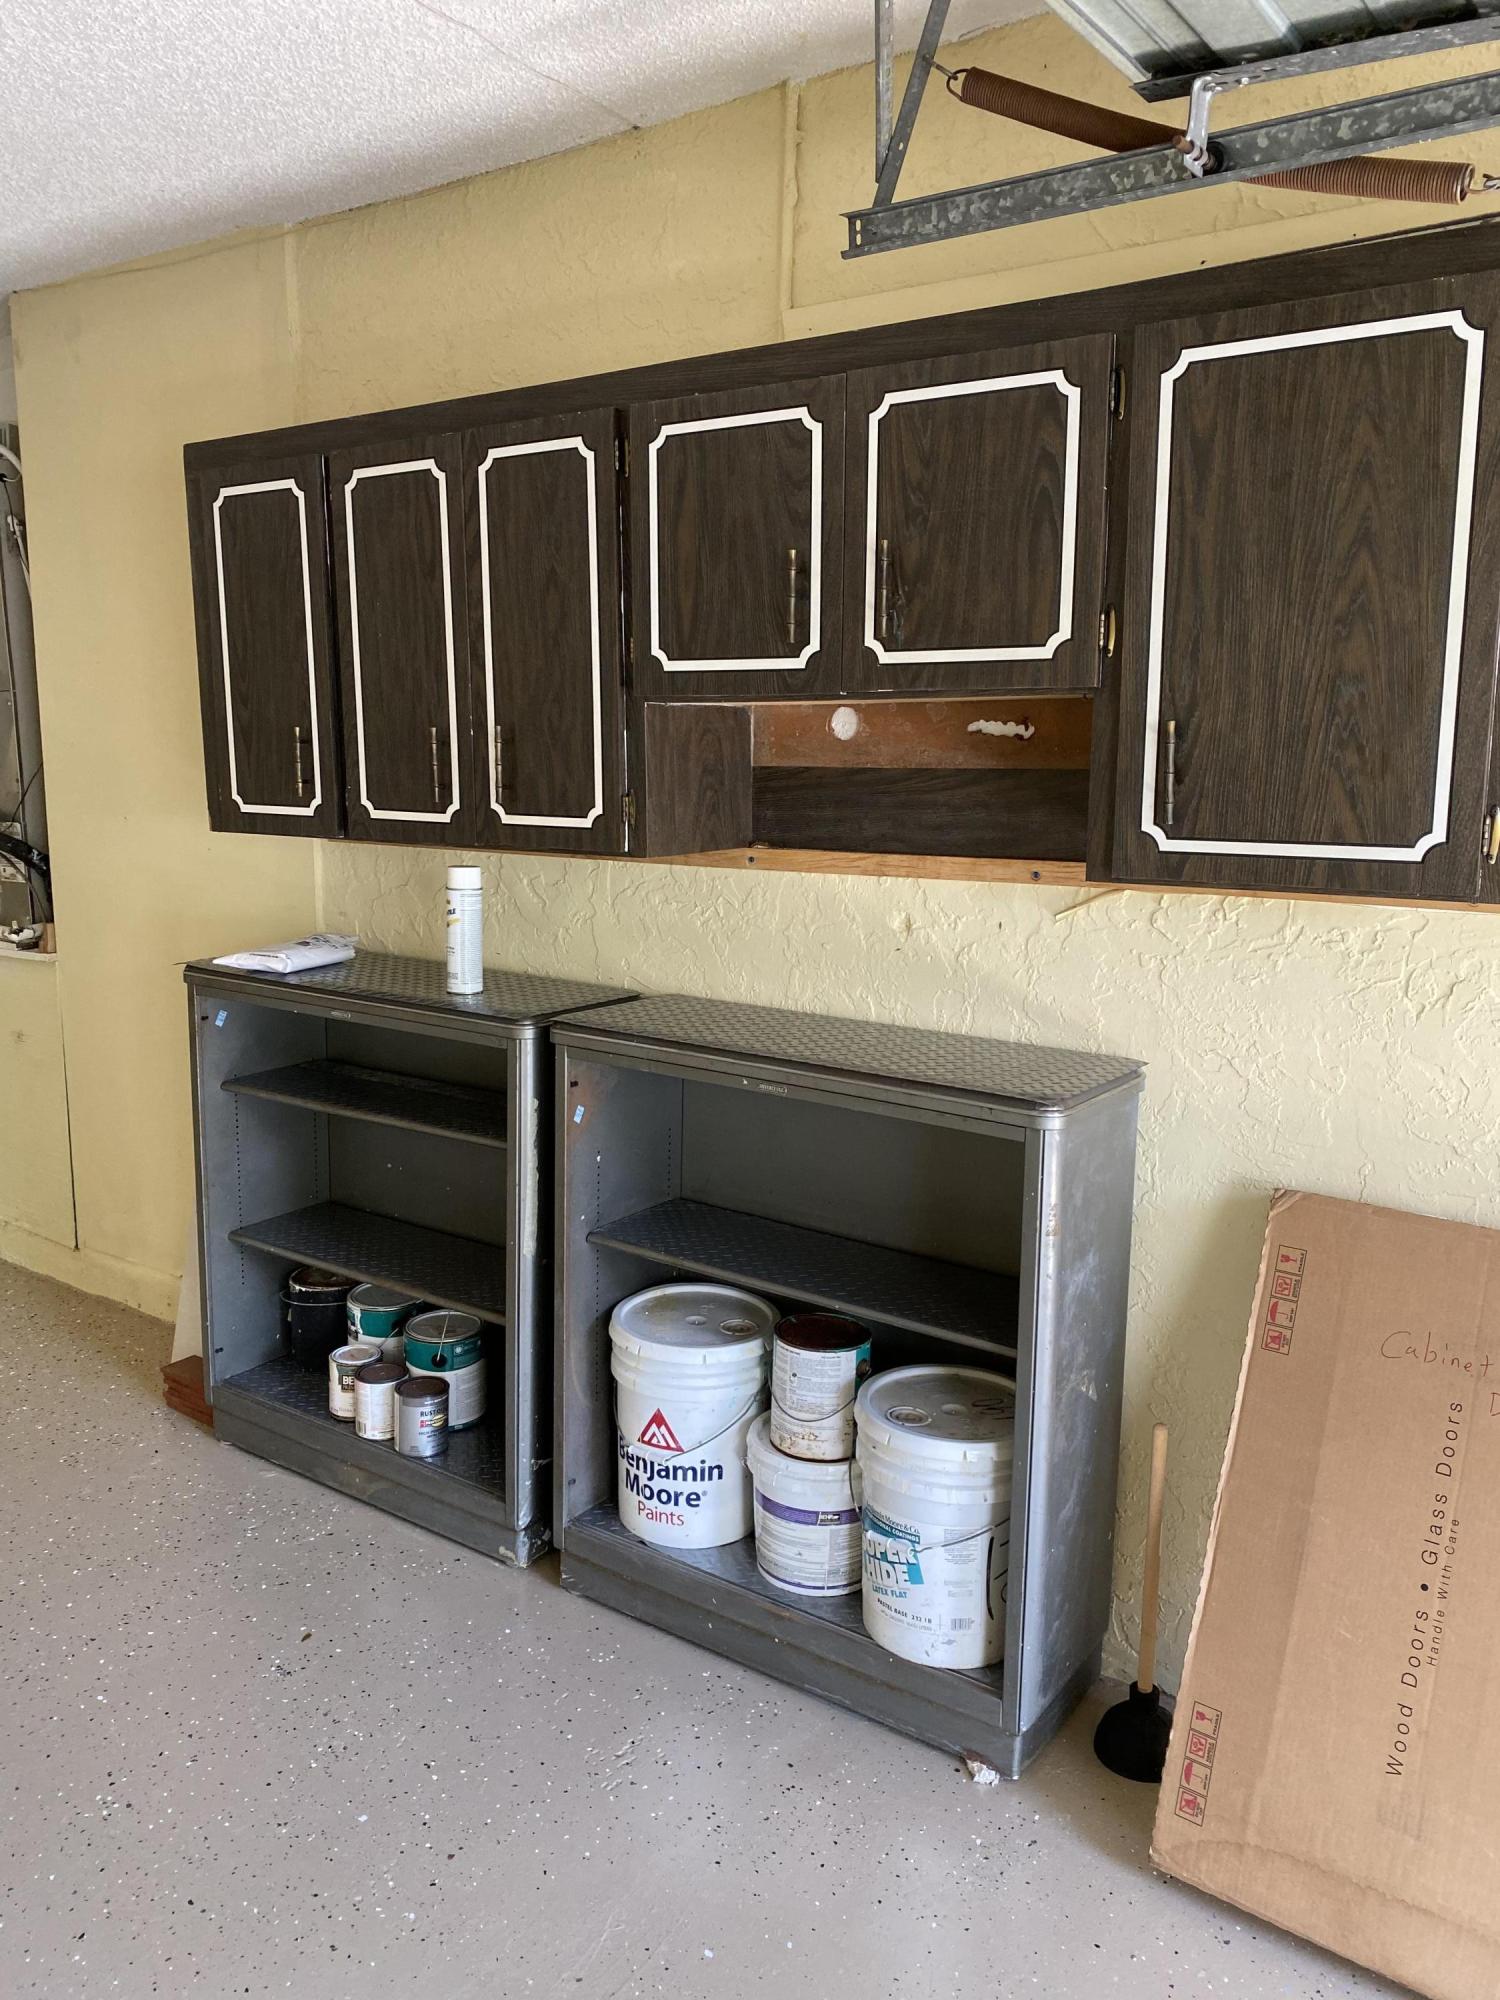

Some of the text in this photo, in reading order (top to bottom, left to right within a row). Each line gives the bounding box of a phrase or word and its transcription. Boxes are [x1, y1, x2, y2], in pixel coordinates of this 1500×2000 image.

[1380, 1330, 1494, 1377] Cabinet
[625, 1467, 701, 1508] Moore
[637, 1500, 685, 1526] Paints
[890, 1589, 908, 1599] FLAT
[1385, 1402, 1463, 1776] Wood Doors Glass Doors
[1426, 1519, 1460, 1667] Handle With Care
